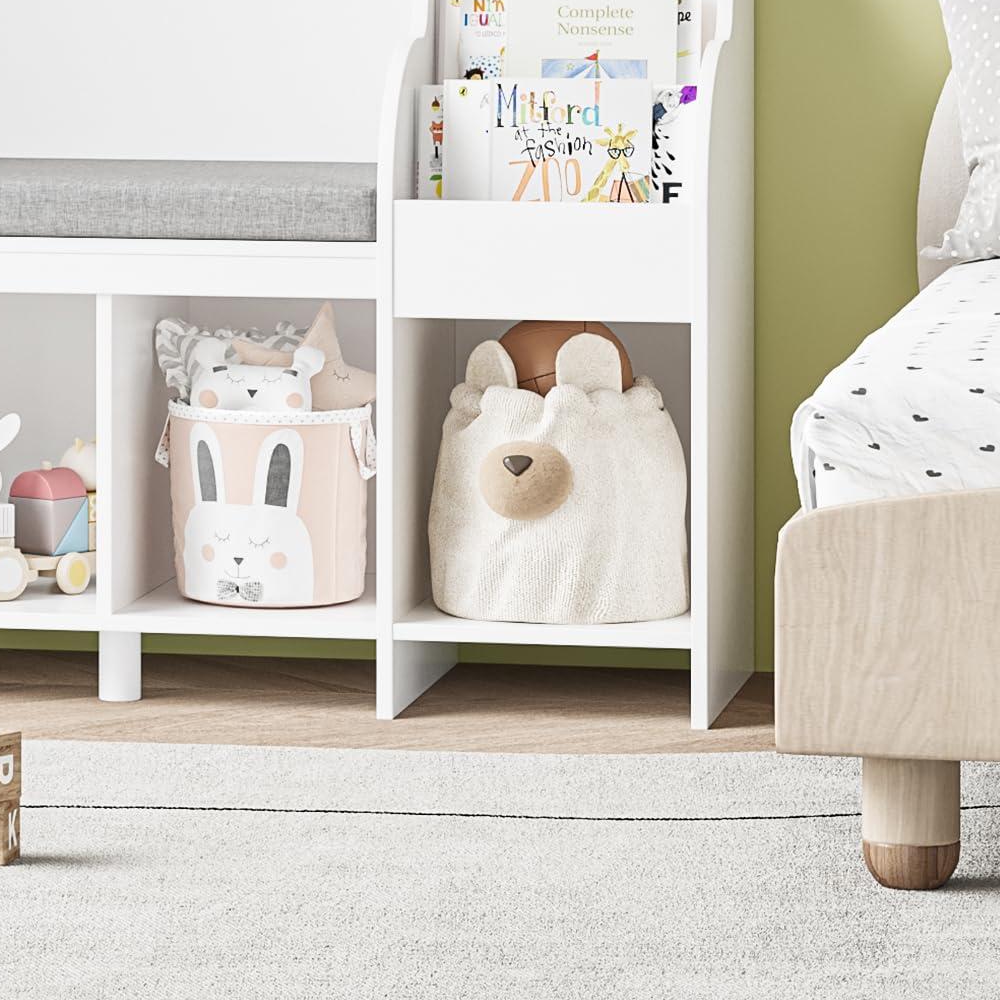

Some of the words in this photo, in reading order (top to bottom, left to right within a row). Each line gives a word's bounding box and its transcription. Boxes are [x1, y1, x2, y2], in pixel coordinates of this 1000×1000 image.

[557, 5, 634, 21] Complete
[557, 22, 634, 36] Nonsense
[514, 125, 529, 141] at
[537, 121, 562, 137] the
[520, 133, 593, 168] fashion
